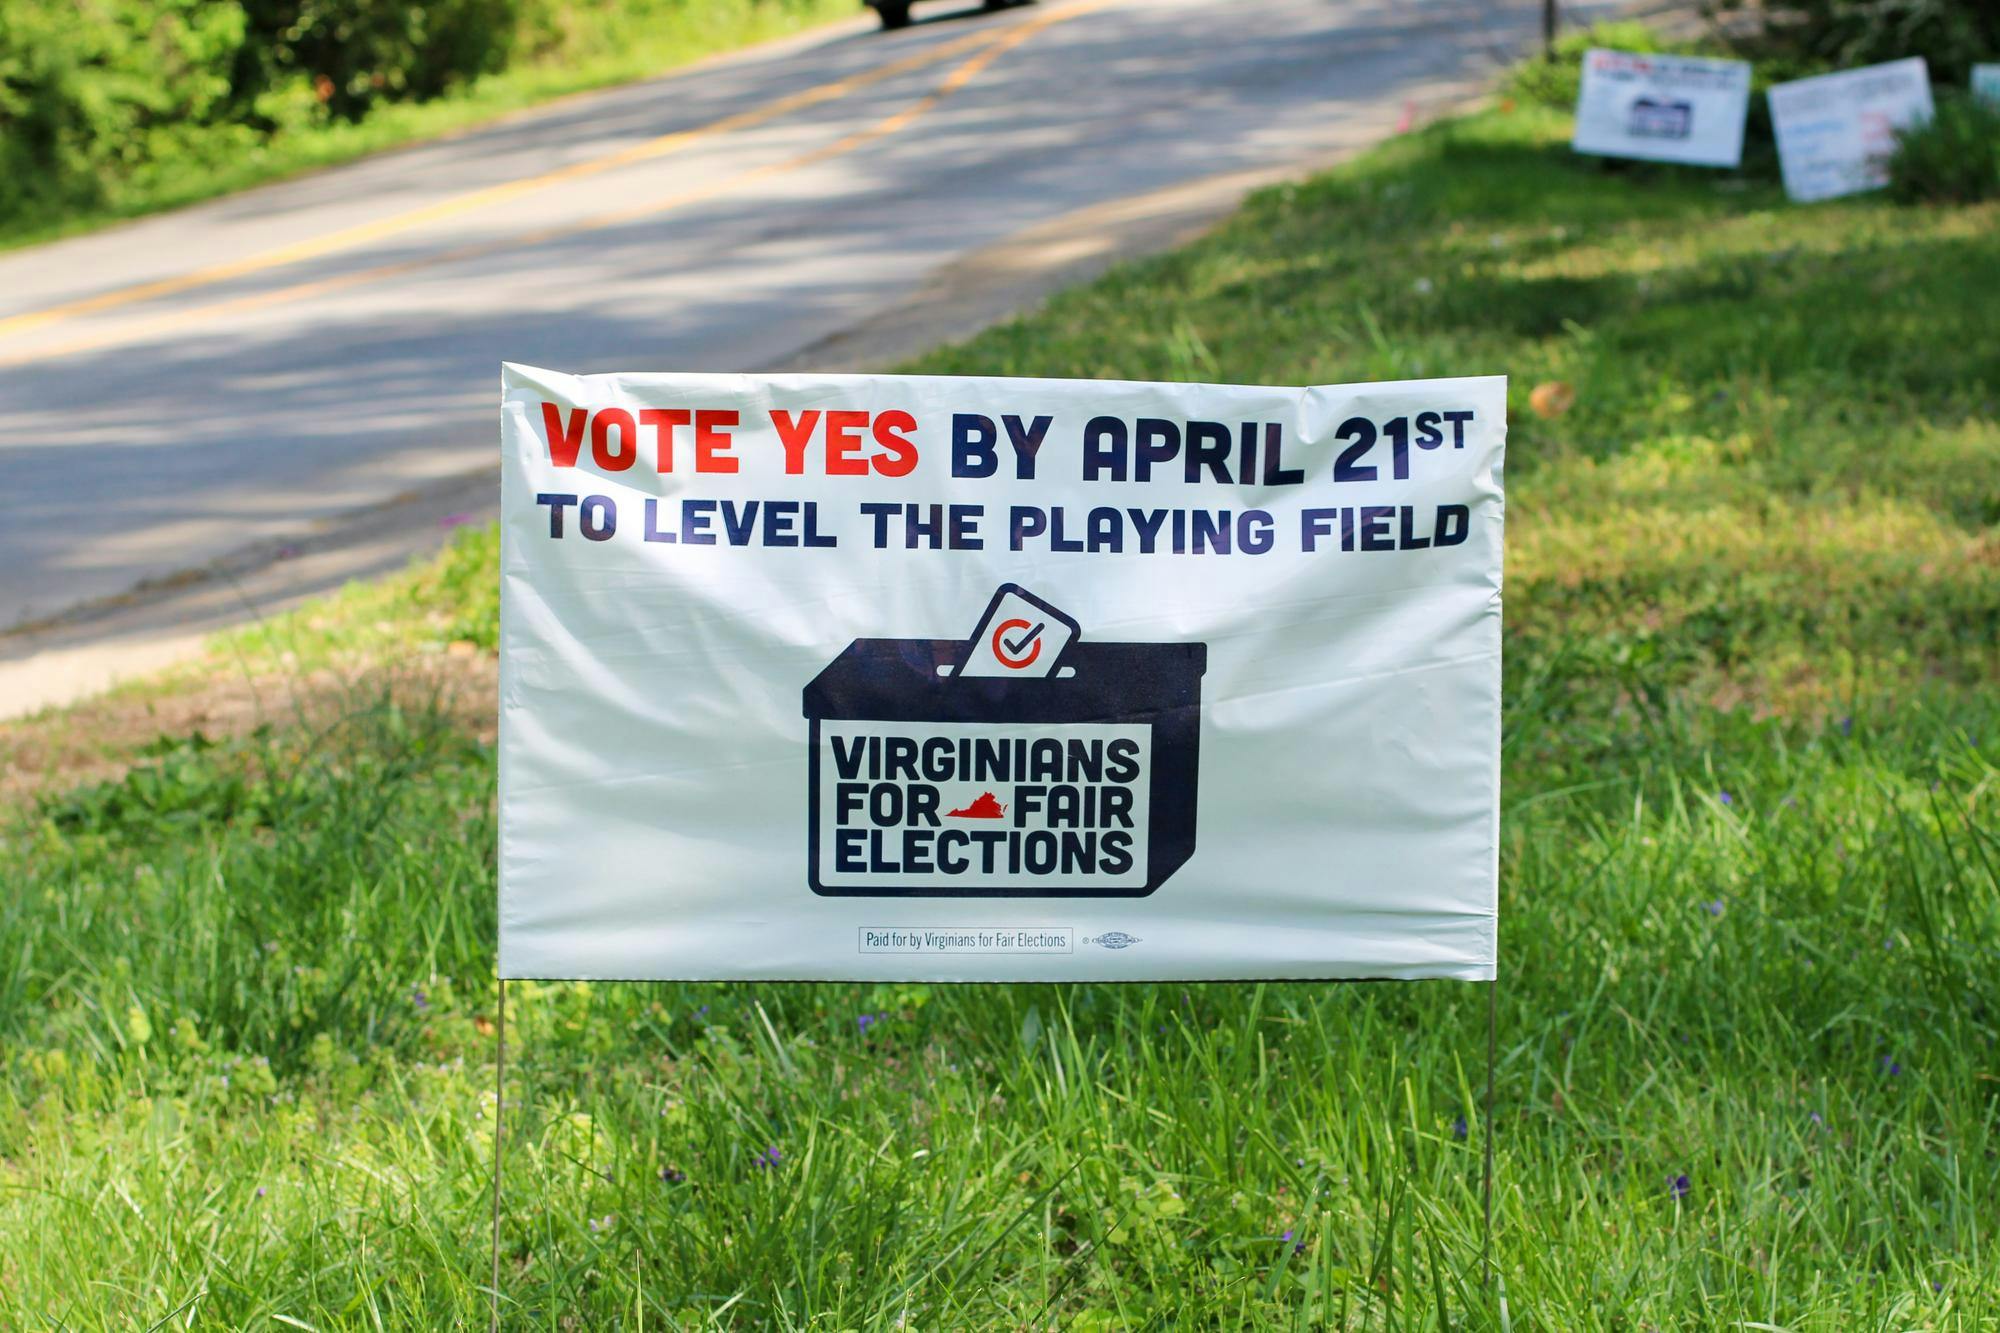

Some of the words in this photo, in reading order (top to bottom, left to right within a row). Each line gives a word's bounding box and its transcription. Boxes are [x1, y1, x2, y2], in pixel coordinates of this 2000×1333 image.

[541, 402, 739, 474] VOTE
[769, 409, 919, 478] YES
[951, 412, 1053, 480] BY
[1083, 415, 1305, 486] APRIL
[1333, 411, 1474, 483] 21ST
[536, 493, 617, 542] TO
[643, 500, 838, 548] LEVEL
[860, 503, 985, 551] THE
[1009, 505, 1274, 556] PLAYING
[1301, 504, 1470, 552] FIELD
[830, 736, 1140, 783] VIRGINIANS
[836, 782, 942, 828] FOR
[1013, 785, 1135, 829] FAIR
[835, 828, 1134, 876] ELECTIONS
[866, 932, 889, 947] Paid
[892, 932, 907, 947] for
[909, 932, 922, 951] by
[925, 932, 976, 950] Virginians
[978, 932, 993, 947] for
[995, 932, 1015, 948] Fair
[1017, 932, 1066, 948] Elections
